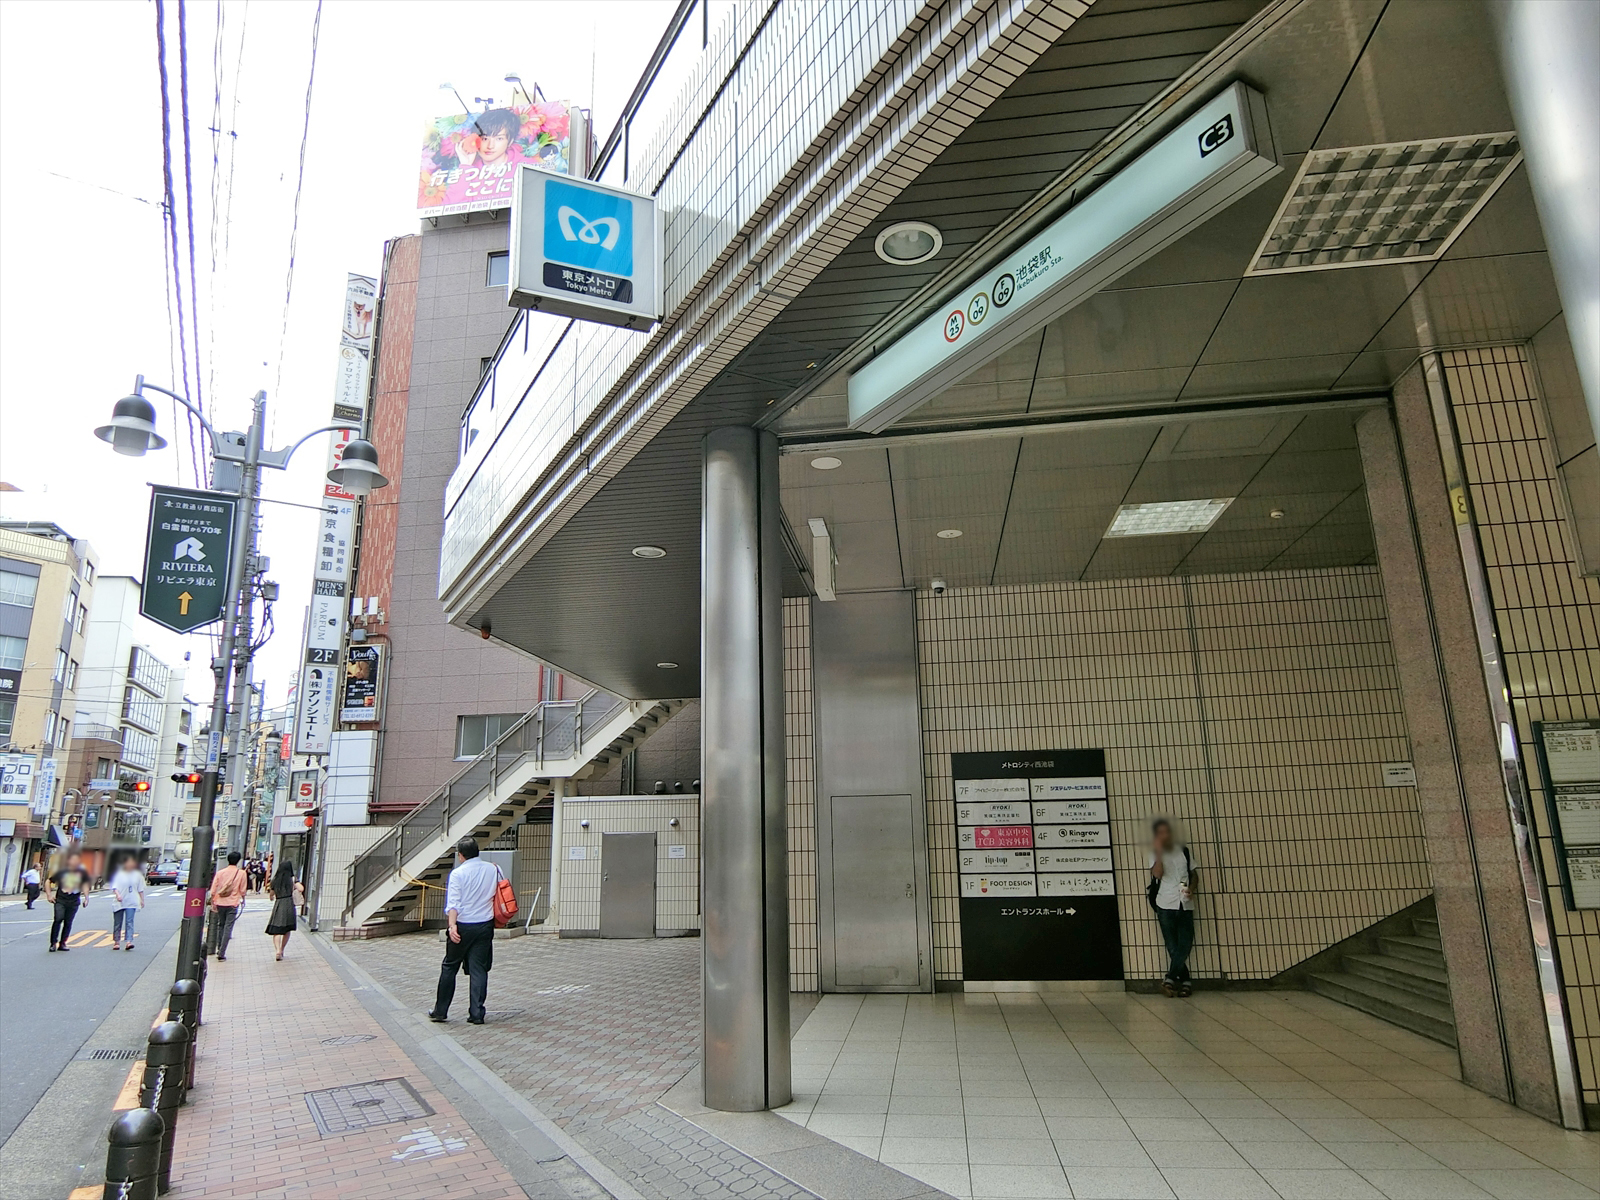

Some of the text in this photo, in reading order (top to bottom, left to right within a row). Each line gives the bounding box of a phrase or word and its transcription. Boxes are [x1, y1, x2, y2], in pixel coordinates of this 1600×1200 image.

[1201, 120, 1229, 152] C3
[430, 162, 513, 187] 行きつけが
[1016, 246, 1052, 283] 池袋駅
[1017, 256, 1064, 291] Ikebukuro Sta.
[562, 270, 615, 289] 東京メトロ
[565, 281, 612, 296] Tokyo Metro
[1001, 280, 1005, 289] F
[998, 288, 1009, 301] 09
[975, 298, 980, 307] Y
[973, 306, 984, 320] 09
[950, 316, 957, 326] M
[950, 324, 959, 337] 25
[335, 540, 345, 573] 協同組合
[162, 561, 213, 573] RIVIERA
[157, 575, 216, 587] リビエラ東京
[317, 581, 343, 590] MEN'S
[316, 588, 337, 596] HAIR
[317, 602, 328, 640] PARFUM
[313, 649, 334, 662] 2F
[1001, 761, 1054, 769] メトロシティ西池袋
[300, 784, 312, 796] 5
[960, 787, 969, 795] 7F
[1035, 785, 1044, 793] 7F
[961, 810, 970, 818] 5F
[1036, 809, 1046, 817] 6F
[997, 829, 1029, 837] 東京中央
[1038, 832, 1048, 840] 4F
[962, 834, 972, 842] 3F
[978, 838, 995, 846] TCB
[998, 838, 1030, 846] 美容外科
[963, 858, 973, 866] 2F
[1040, 857, 1050, 865] 2F
[965, 882, 975, 890] 1F
[1042, 881, 1051, 889] 1F
[1001, 907, 1064, 916] エントランスホール
